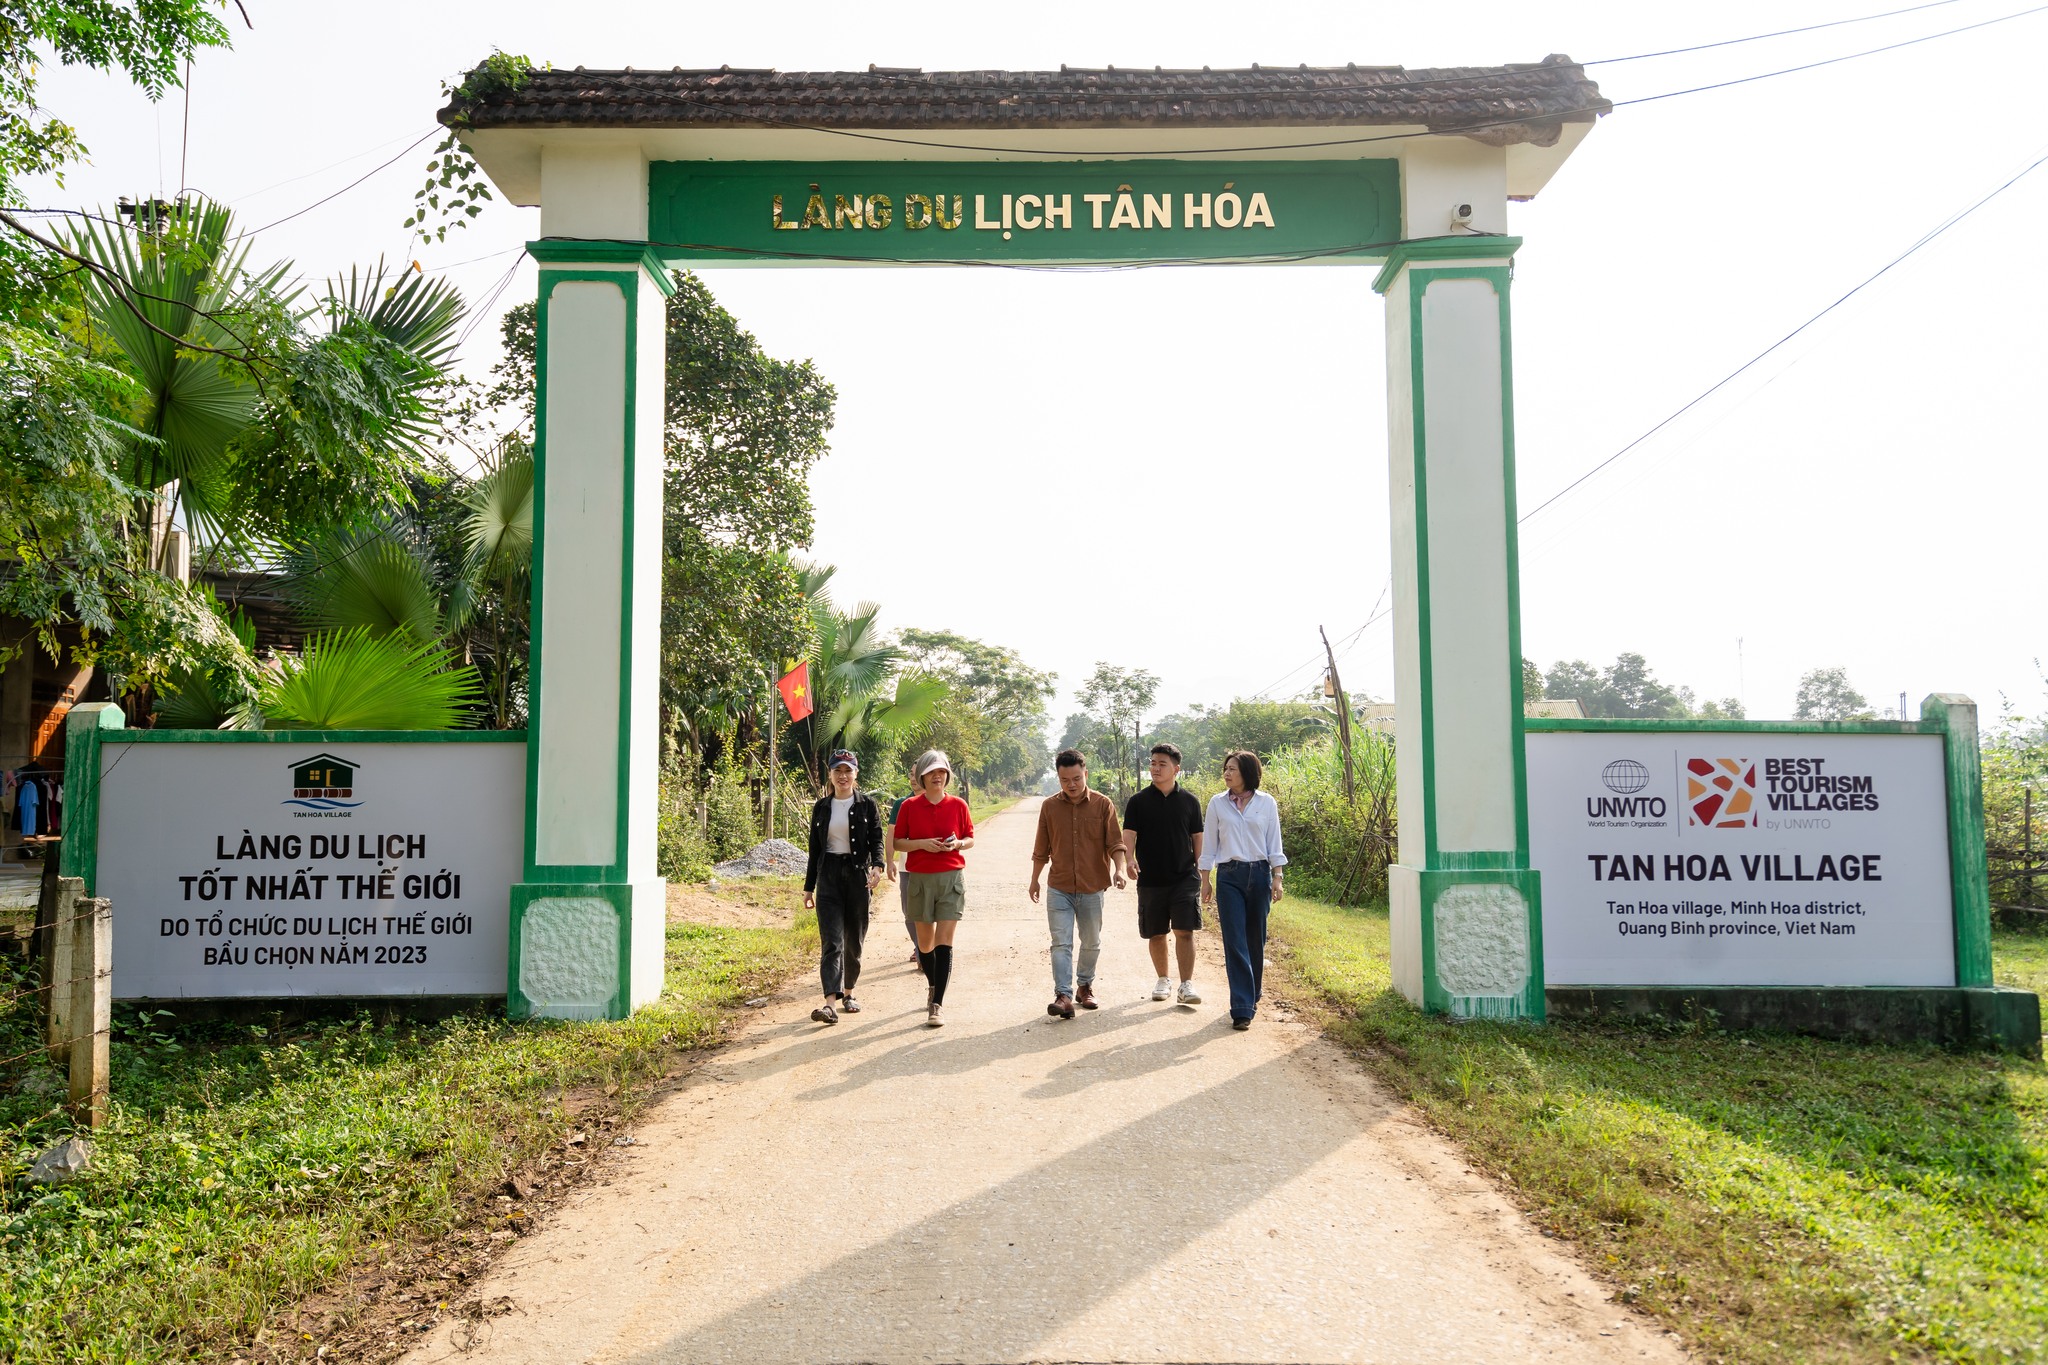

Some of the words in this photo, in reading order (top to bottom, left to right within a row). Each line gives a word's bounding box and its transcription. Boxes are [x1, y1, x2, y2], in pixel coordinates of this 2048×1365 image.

[772, 183, 893, 231] LÀNG
[904, 193, 963, 230] DU
[974, 193, 1072, 241] LỊCH
[1084, 183, 1173, 230] TÂN
[1184, 182, 1275, 229] HÓA
[1765, 758, 1825, 775] BEST
[1766, 776, 1873, 793] TOURISM
[1587, 797, 1667, 818] UNWTO
[1767, 794, 1879, 811] VILLAGES
[1766, 818, 1781, 832] by
[1784, 819, 1830, 829] UNWTO
[217, 829, 301, 860] LÀNG
[310, 835, 349, 859] DU
[358, 835, 425, 866] LỊCH
[1588, 855, 1654, 881] TAN
[1664, 855, 1732, 881] HOA
[1740, 855, 1881, 881] VILLAGE
[179, 868, 238, 901] TỐT
[246, 867, 334, 900] NHẤT
[336, 865, 398, 899] THẾ
[403, 869, 460, 899] GIỚI
[1607, 901, 1634, 914] Tan
[1639, 901, 1668, 914] Hoa
[1672, 901, 1726, 917] village,
[1731, 901, 1766, 914] Minh
[1771, 901, 1800, 914] Hoa
[1804, 901, 1866, 917] district,
[161, 919, 189, 936] DO
[195, 910, 223, 936] TỔ
[229, 914, 287, 936] CHỨC
[294, 918, 322, 935] DU
[329, 917, 376, 940] LỊCH
[383, 911, 427, 934] THẾ
[431, 913, 471, 934] GIỚI
[1619, 921, 1666, 937] Quang
[1671, 921, 1705, 934] Binh
[1709, 921, 1780, 937] province,
[1785, 921, 1816, 934] Viet
[1821, 922, 1855, 934] Nam
[204, 940, 248, 965] BẦU
[255, 947, 314, 969] CHỌN
[321, 942, 368, 964] NĂM
[375, 946, 427, 964] 2023
